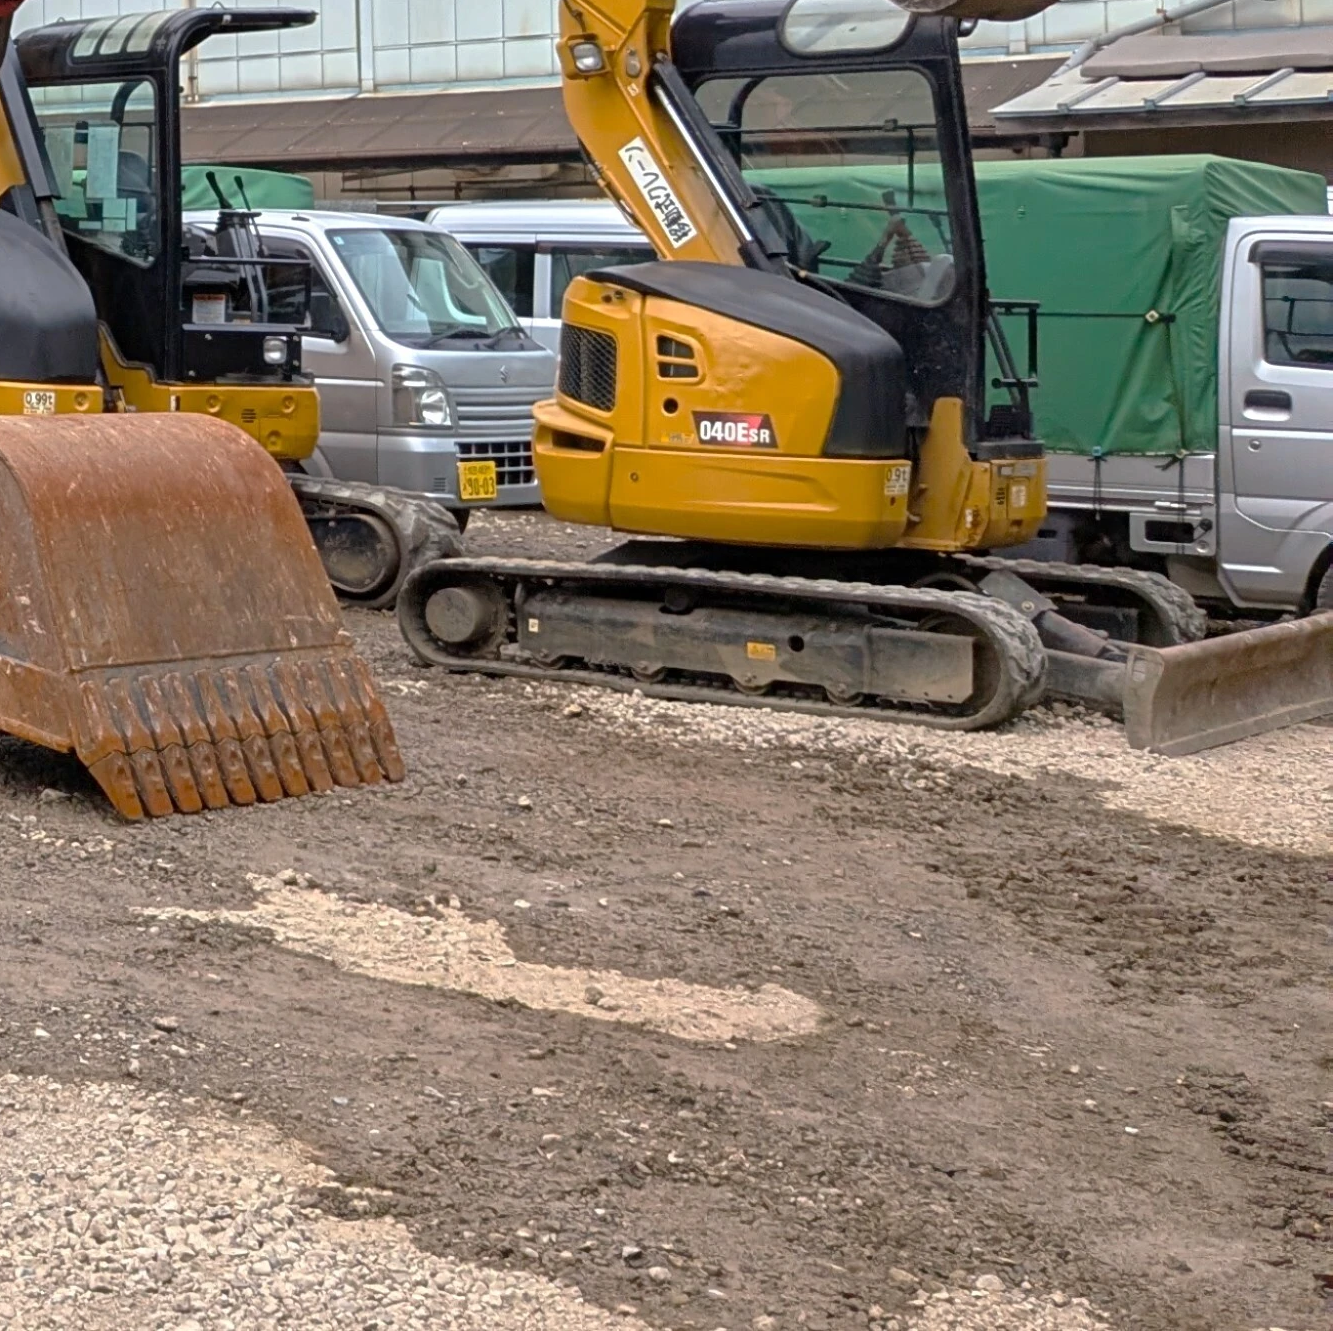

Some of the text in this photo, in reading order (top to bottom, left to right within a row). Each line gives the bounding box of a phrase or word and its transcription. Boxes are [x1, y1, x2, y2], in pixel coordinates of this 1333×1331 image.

[624, 146, 693, 243] 移動式クレーン
[699, 420, 771, 444] 040ESR
[466, 476, 495, 497] 90-03
